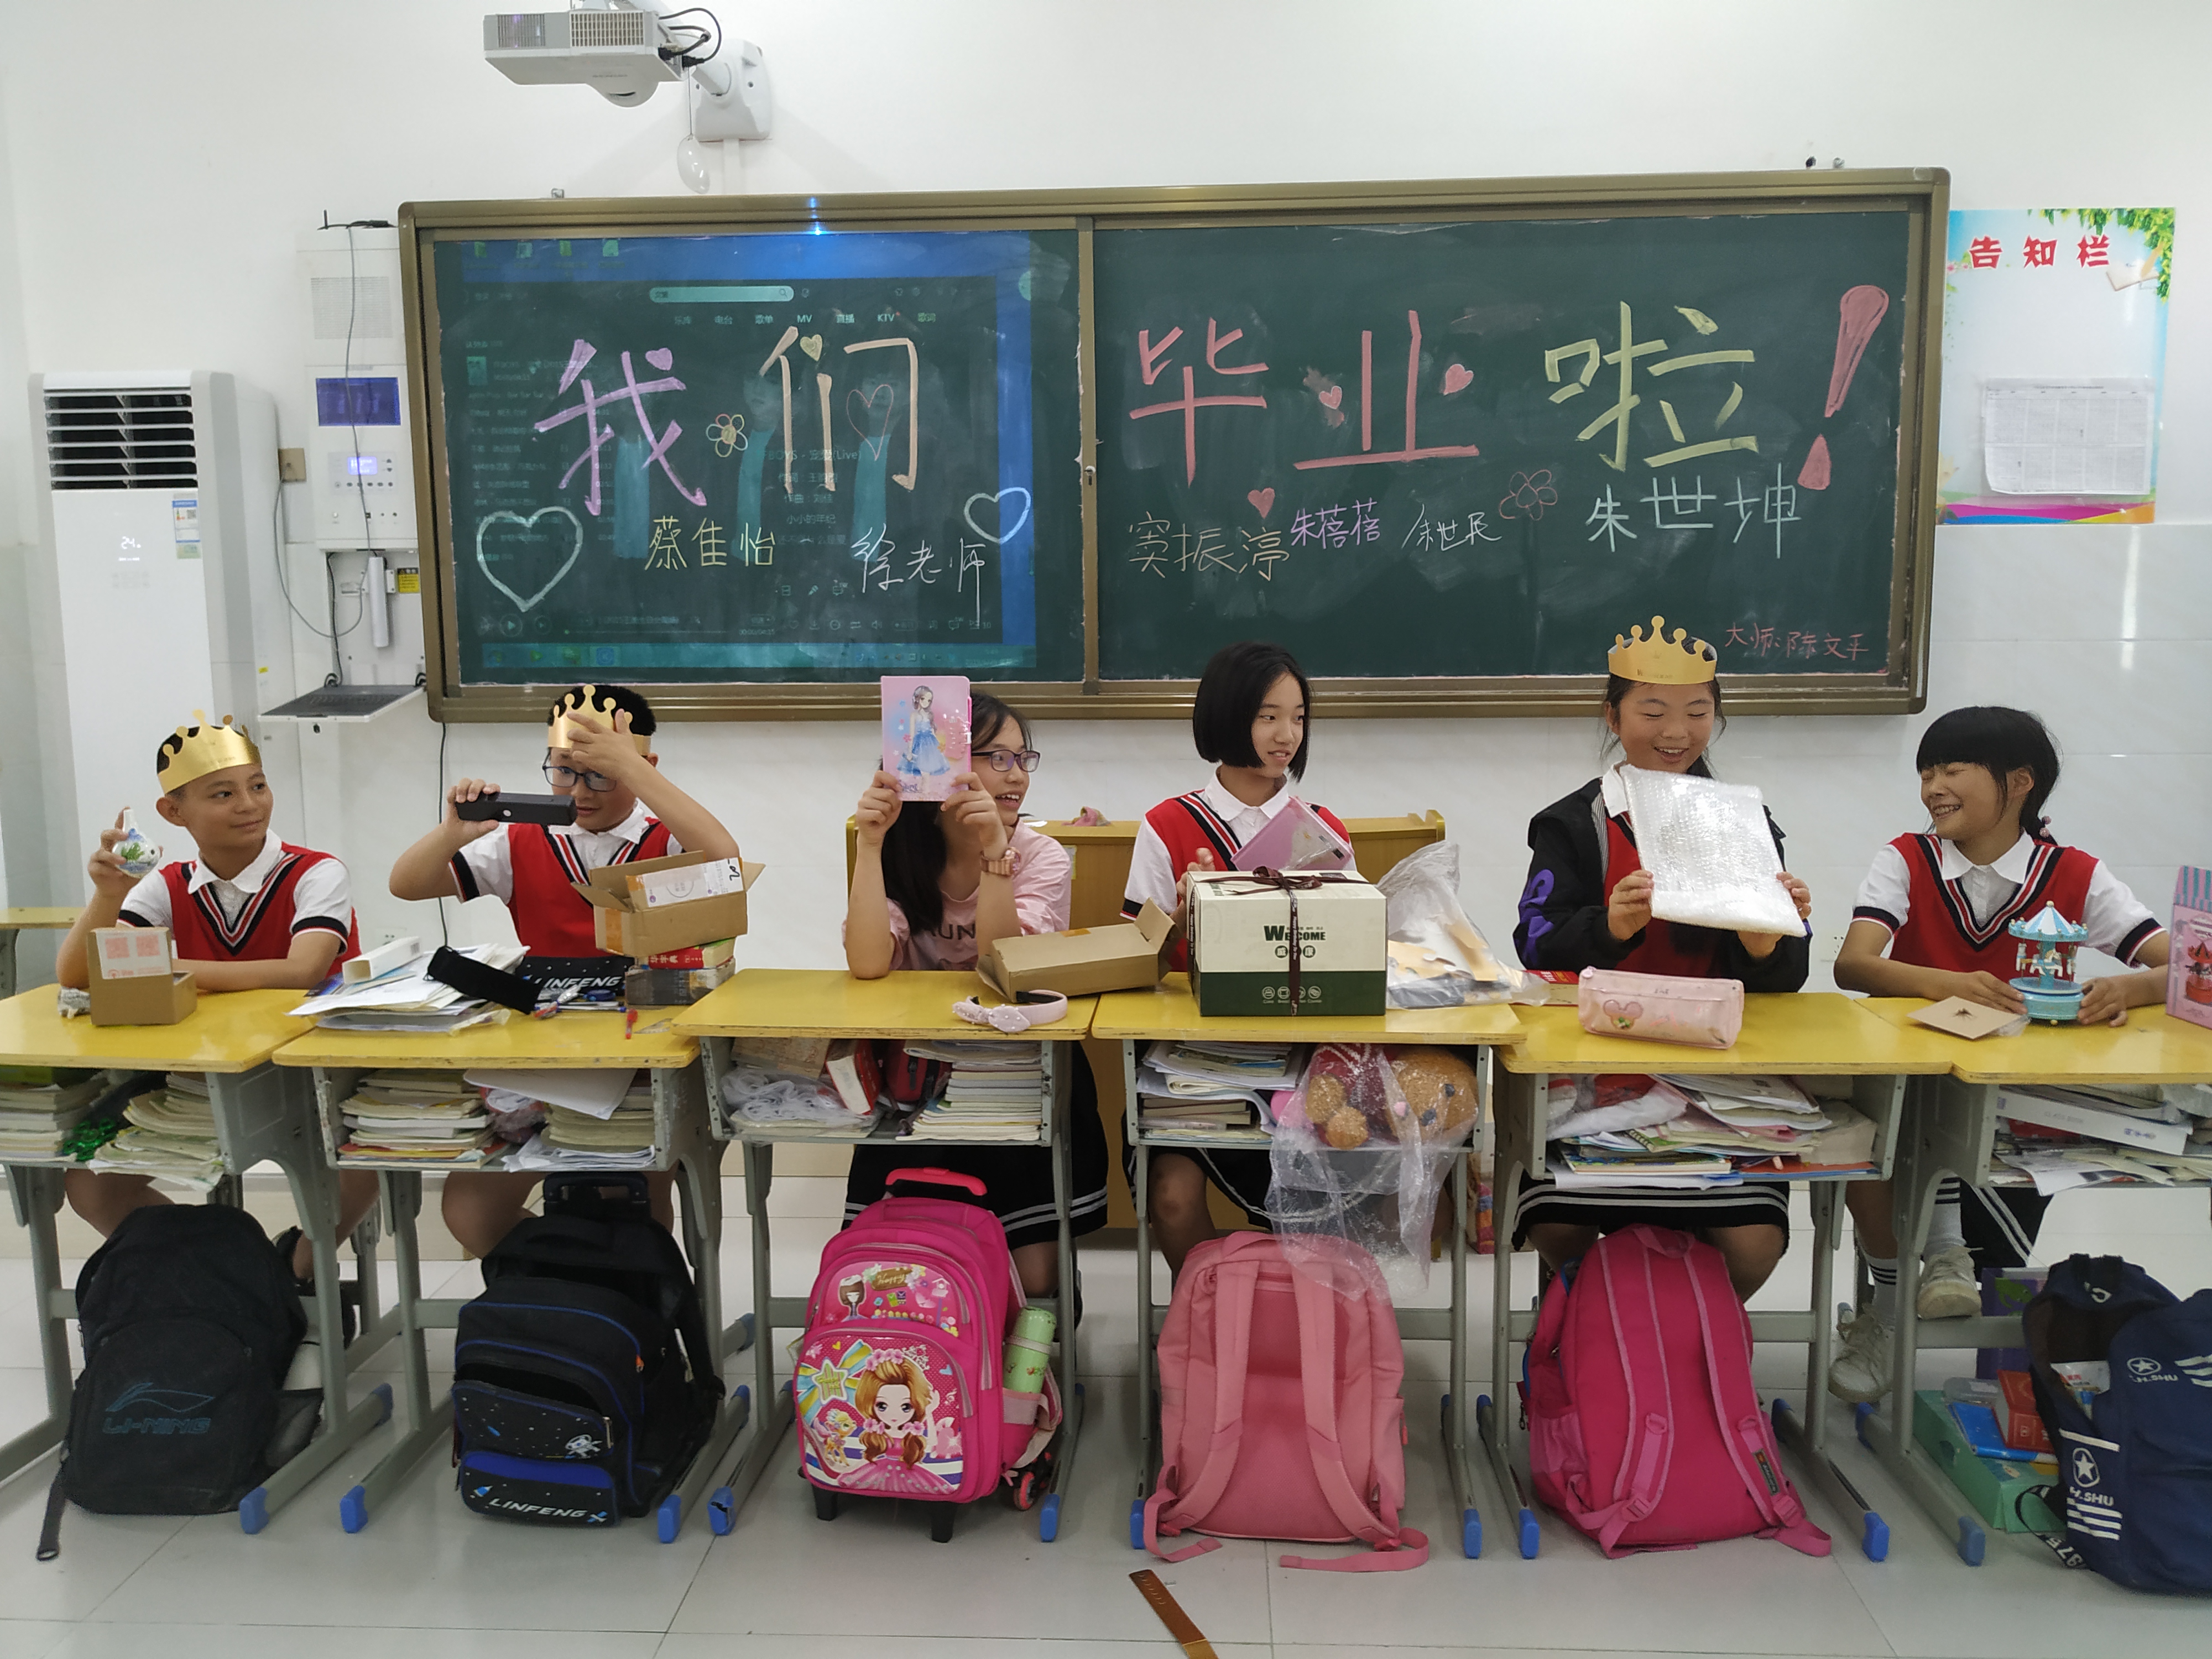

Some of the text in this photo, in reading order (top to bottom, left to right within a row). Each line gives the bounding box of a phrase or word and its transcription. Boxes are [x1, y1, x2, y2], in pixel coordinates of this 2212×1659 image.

[1969, 234, 2111, 268] 告知栏
[755, 315, 773, 325] 歌单
[797, 315, 812, 323] MV
[878, 314, 895, 322] KTV
[534, 326, 918, 515] 我们
[786, 514, 836, 525] 小小的年纪
[1586, 463, 1802, 559] 朱世坤
[1290, 498, 1380, 549] 朱蓓蓓
[851, 523, 985, 629] 徐老师
[931, 921, 976, 940] UN
[1264, 925, 1326, 941] WECOME
[534, 975, 623, 988] INFENG
[489, 1498, 588, 1517] LINFENG
